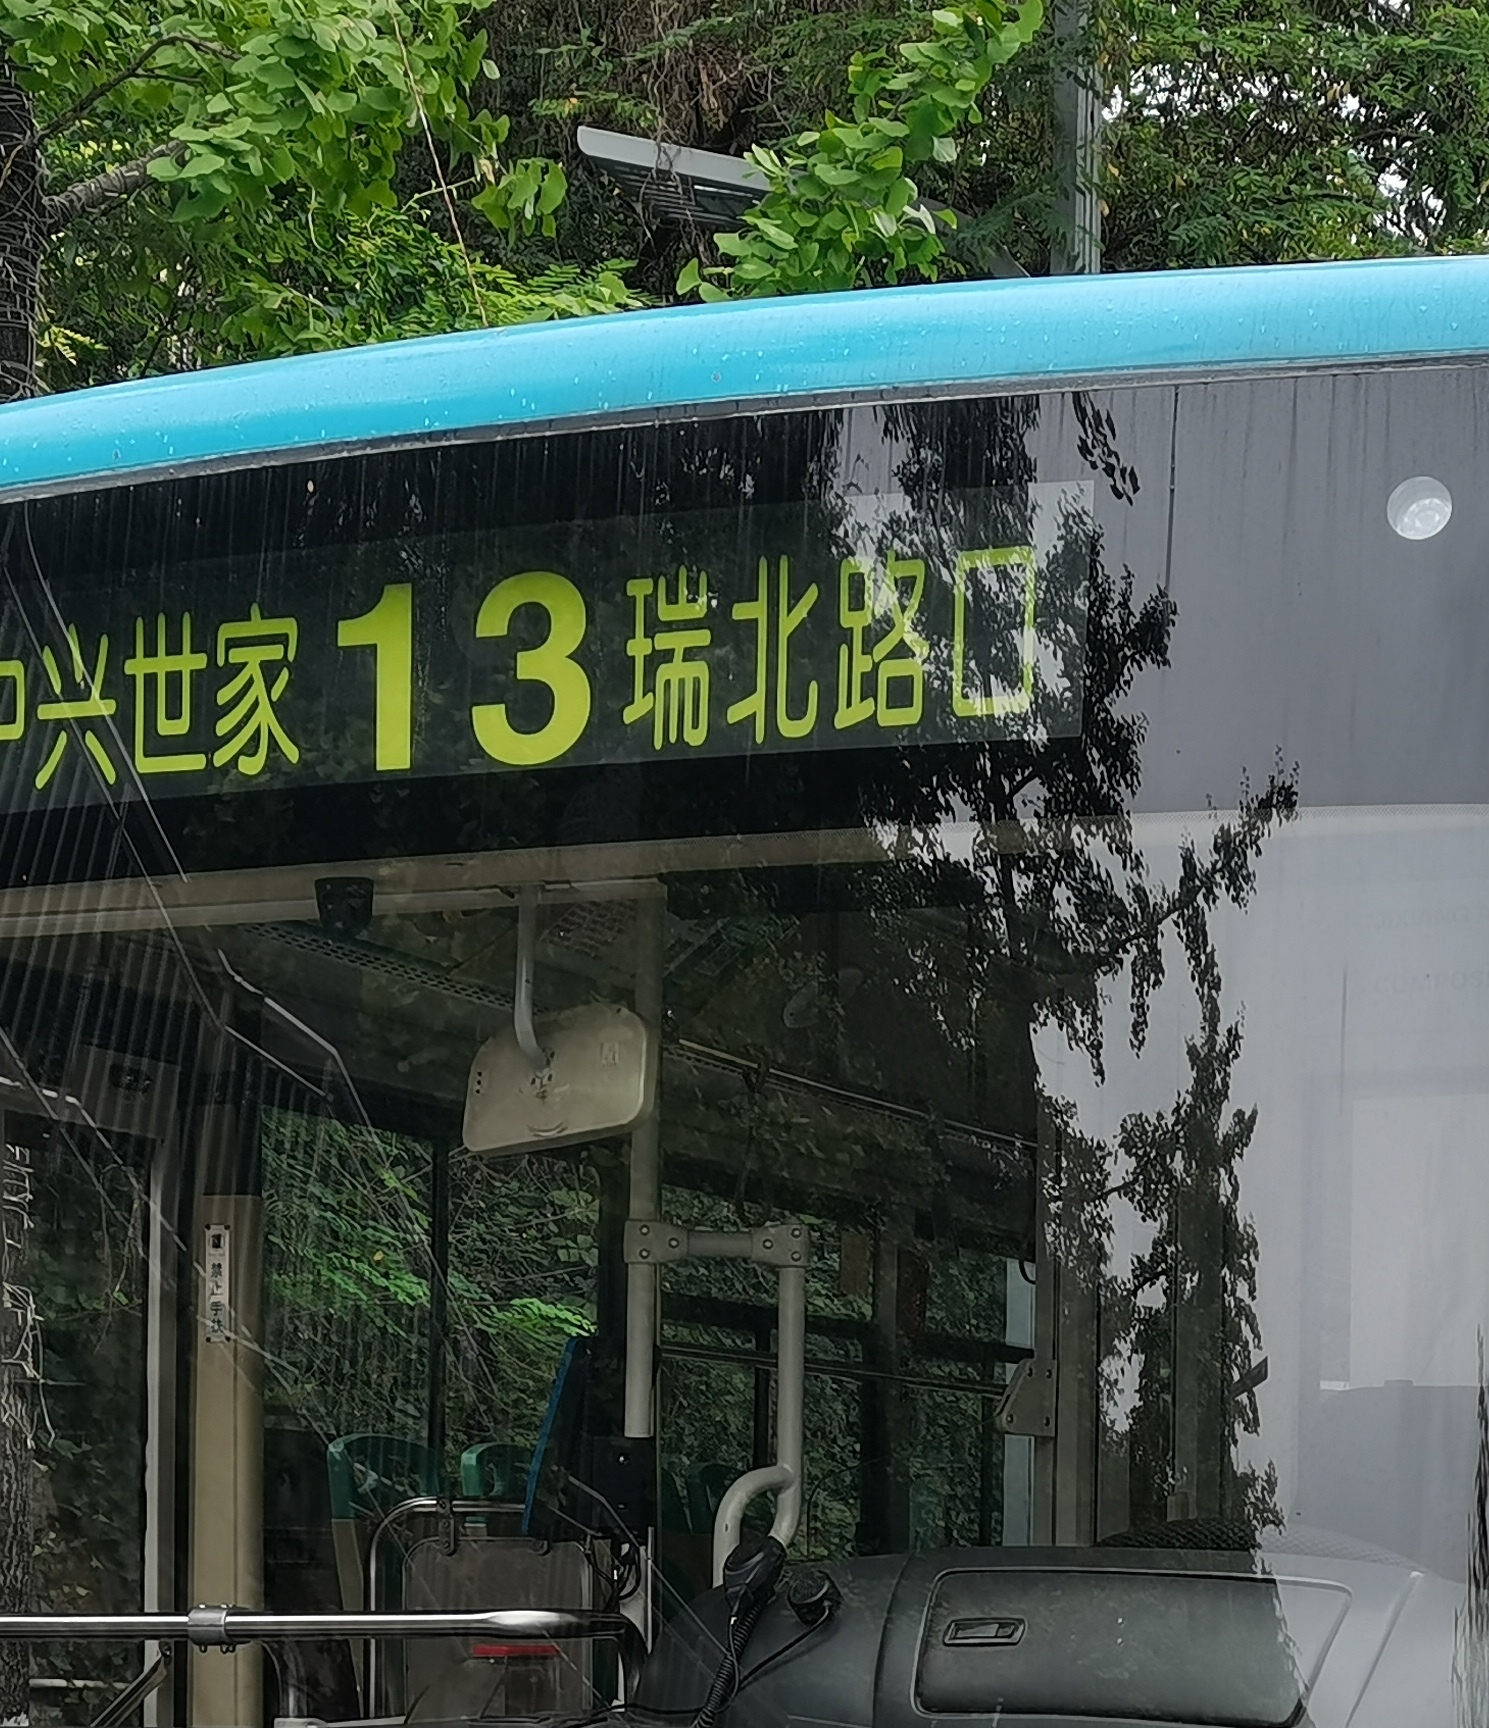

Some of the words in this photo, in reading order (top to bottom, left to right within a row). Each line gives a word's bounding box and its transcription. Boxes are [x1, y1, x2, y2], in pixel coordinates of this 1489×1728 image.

[336, 570, 592, 772] 13
[623, 545, 1036, 753] 瑞北路口
